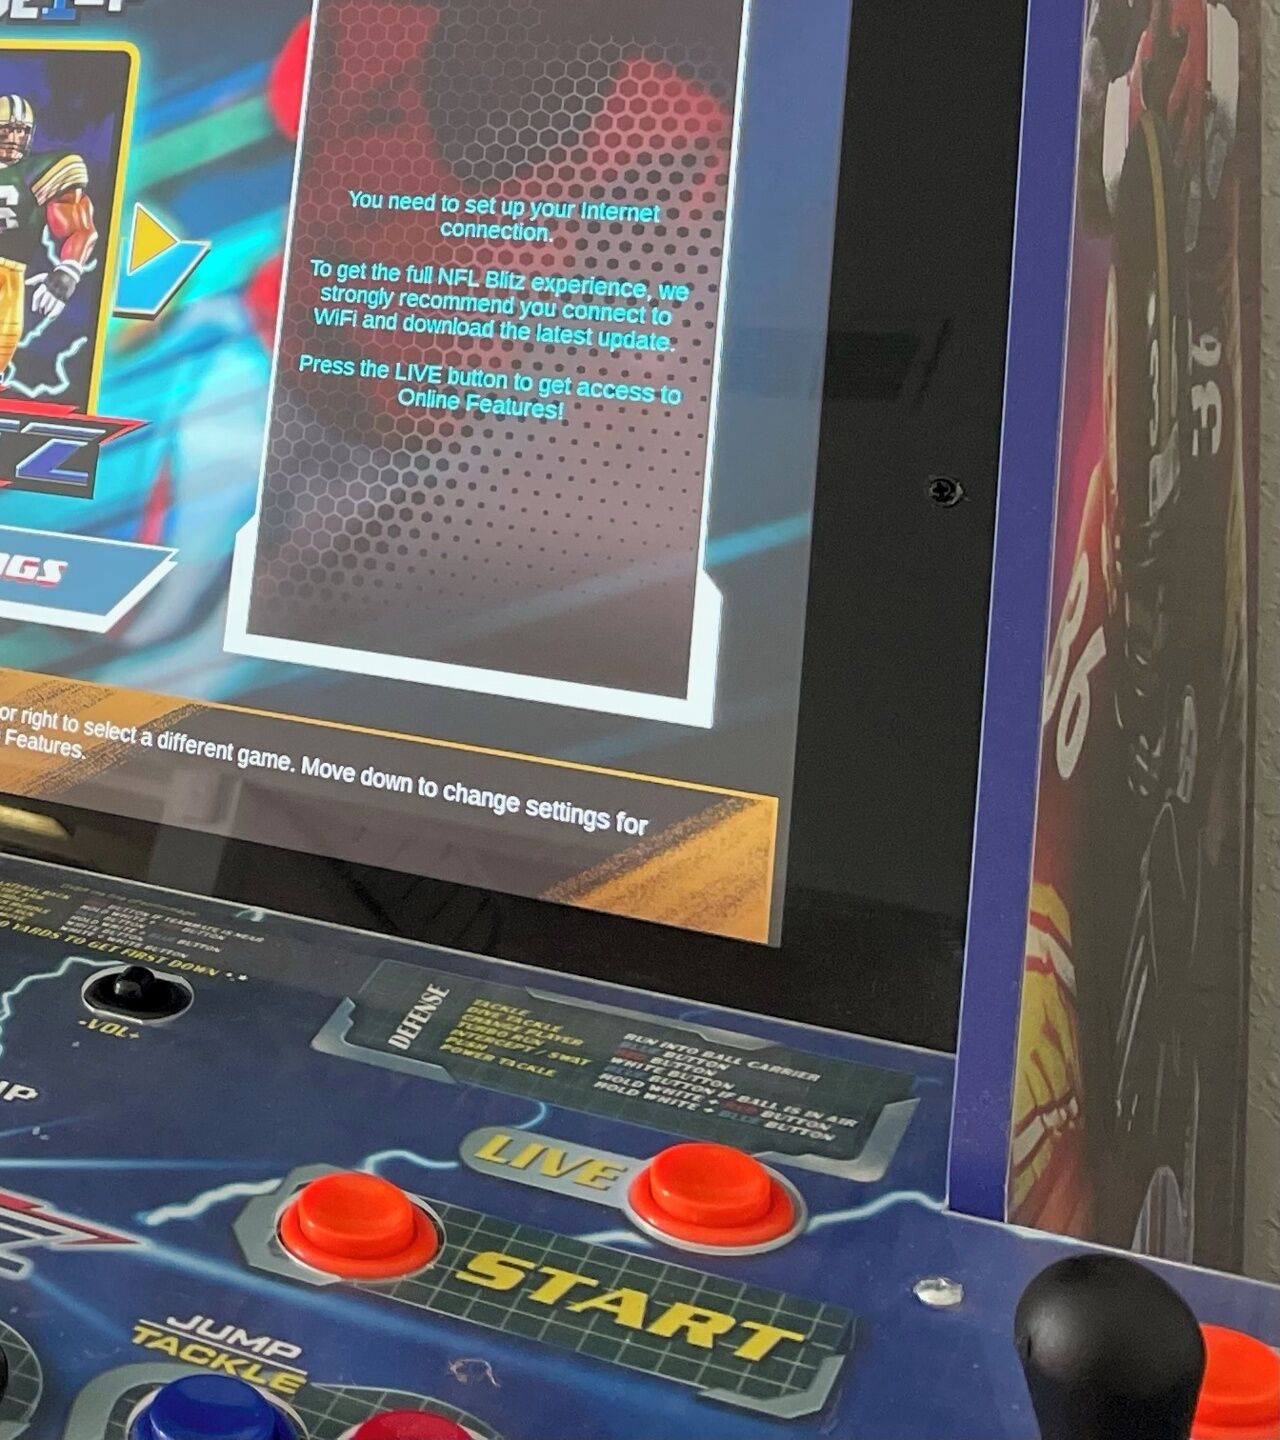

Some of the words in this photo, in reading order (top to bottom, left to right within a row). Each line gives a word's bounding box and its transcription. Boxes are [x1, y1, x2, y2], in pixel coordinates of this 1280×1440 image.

[348, 190, 384, 209] You
[389, 194, 436, 212] need
[441, 196, 461, 214] to
[465, 198, 496, 216] set
[500, 200, 525, 220] up
[529, 202, 575, 221] your
[439, 220, 554, 243] connection.
[310, 259, 333, 278] To
[337, 262, 367, 283] get
[370, 262, 402, 282] the
[405, 264, 433, 285] full
[437, 266, 479, 288] NFL
[484, 270, 525, 291] Blitz
[531, 274, 653, 303] experience,
[658, 284, 689, 302] we
[320, 284, 394, 310] strongly
[399, 290, 514, 315] recommend
[519, 300, 557, 321] you
[561, 301, 647, 325] connect
[651, 307, 673, 326] to
[313, 308, 358, 327] WiFi
[362, 311, 397, 331] and
[402, 315, 495, 340] download
[499, 321, 531, 341] the
[535, 323, 594, 346] latest
[597, 329, 677, 354] update.
[299, 355, 355, 376] Press
[359, 359, 391, 379] the
[395, 362, 443, 385] LIVE
[446, 366, 509, 390] button
[513, 373, 534, 392] to
[538, 377, 572, 399] get
[576, 378, 655, 403] access
[660, 385, 681, 405] to
[397, 388, 460, 411] Online
[465, 392, 565, 420] Features!
[4, 728, 87, 760] Features.
[0, 704, 18, 721] or
[21, 705, 59, 733] right
[61, 713, 79, 733] to
[83, 718, 137, 745] select
[140, 731, 153, 747] a
[156, 728, 234, 763] different
[237, 745, 296, 773] game.
[300, 755, 356, 784] Move
[360, 766, 414, 794] down
[417, 774, 438, 799] to
[442, 780, 521, 815] change
[524, 796, 612, 832] settings
[615, 810, 650, 837] for
[11, 923, 62, 940] YARDS
[64, 933, 87, 945] TO
[87, 940, 123, 954] GET
[120, 947, 169, 964] FIRST
[167, 958, 221, 976] DOWN
[388, 983, 451, 1051] DEFENSE
[473, 1133, 631, 1190] LIVE
[457, 1250, 807, 1362] START
[131, 1325, 310, 1395] TACKLE
[166, 1314, 303, 1360] JUMP
